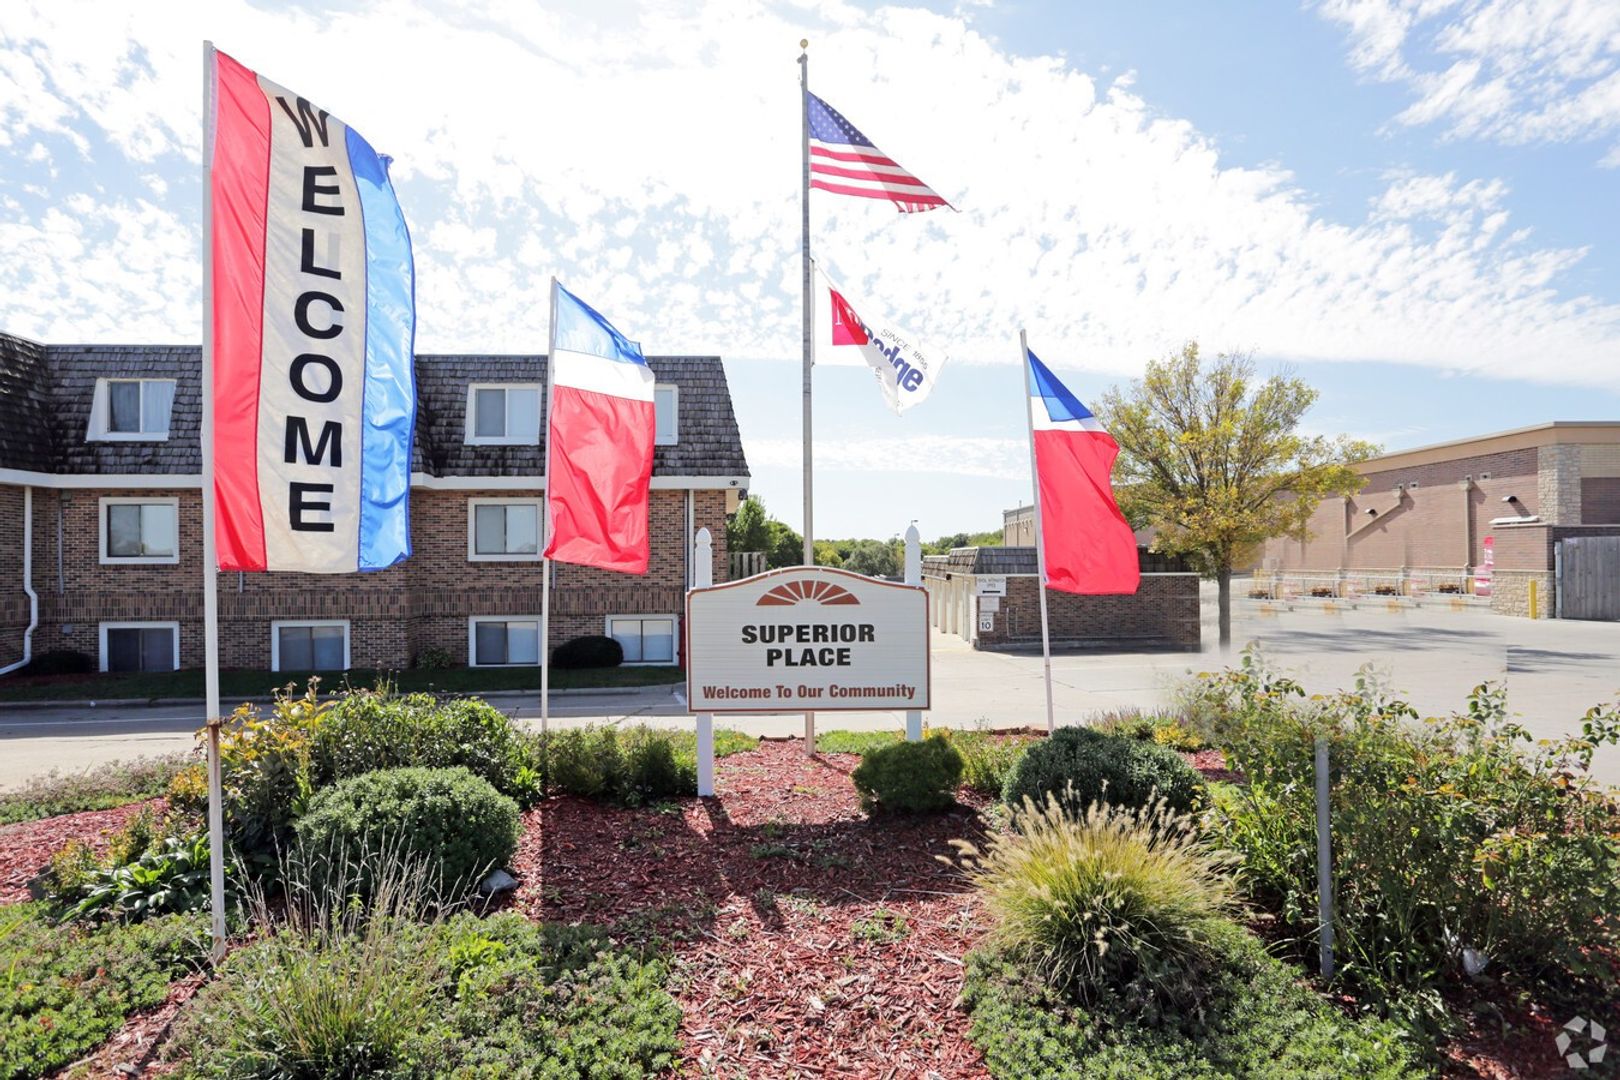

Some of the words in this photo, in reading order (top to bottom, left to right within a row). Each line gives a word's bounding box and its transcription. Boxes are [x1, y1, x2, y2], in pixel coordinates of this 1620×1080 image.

[275, 97, 345, 532] WELCOME
[881, 329, 911, 352] SINCE
[741, 624, 875, 643] SUPERIOR
[981, 621, 992, 630] 10
[766, 648, 851, 667] PLACE
[703, 686, 771, 699] Welcome
[776, 685, 792, 698] To
[797, 685, 824, 698] Our
[829, 684, 916, 700] Community
